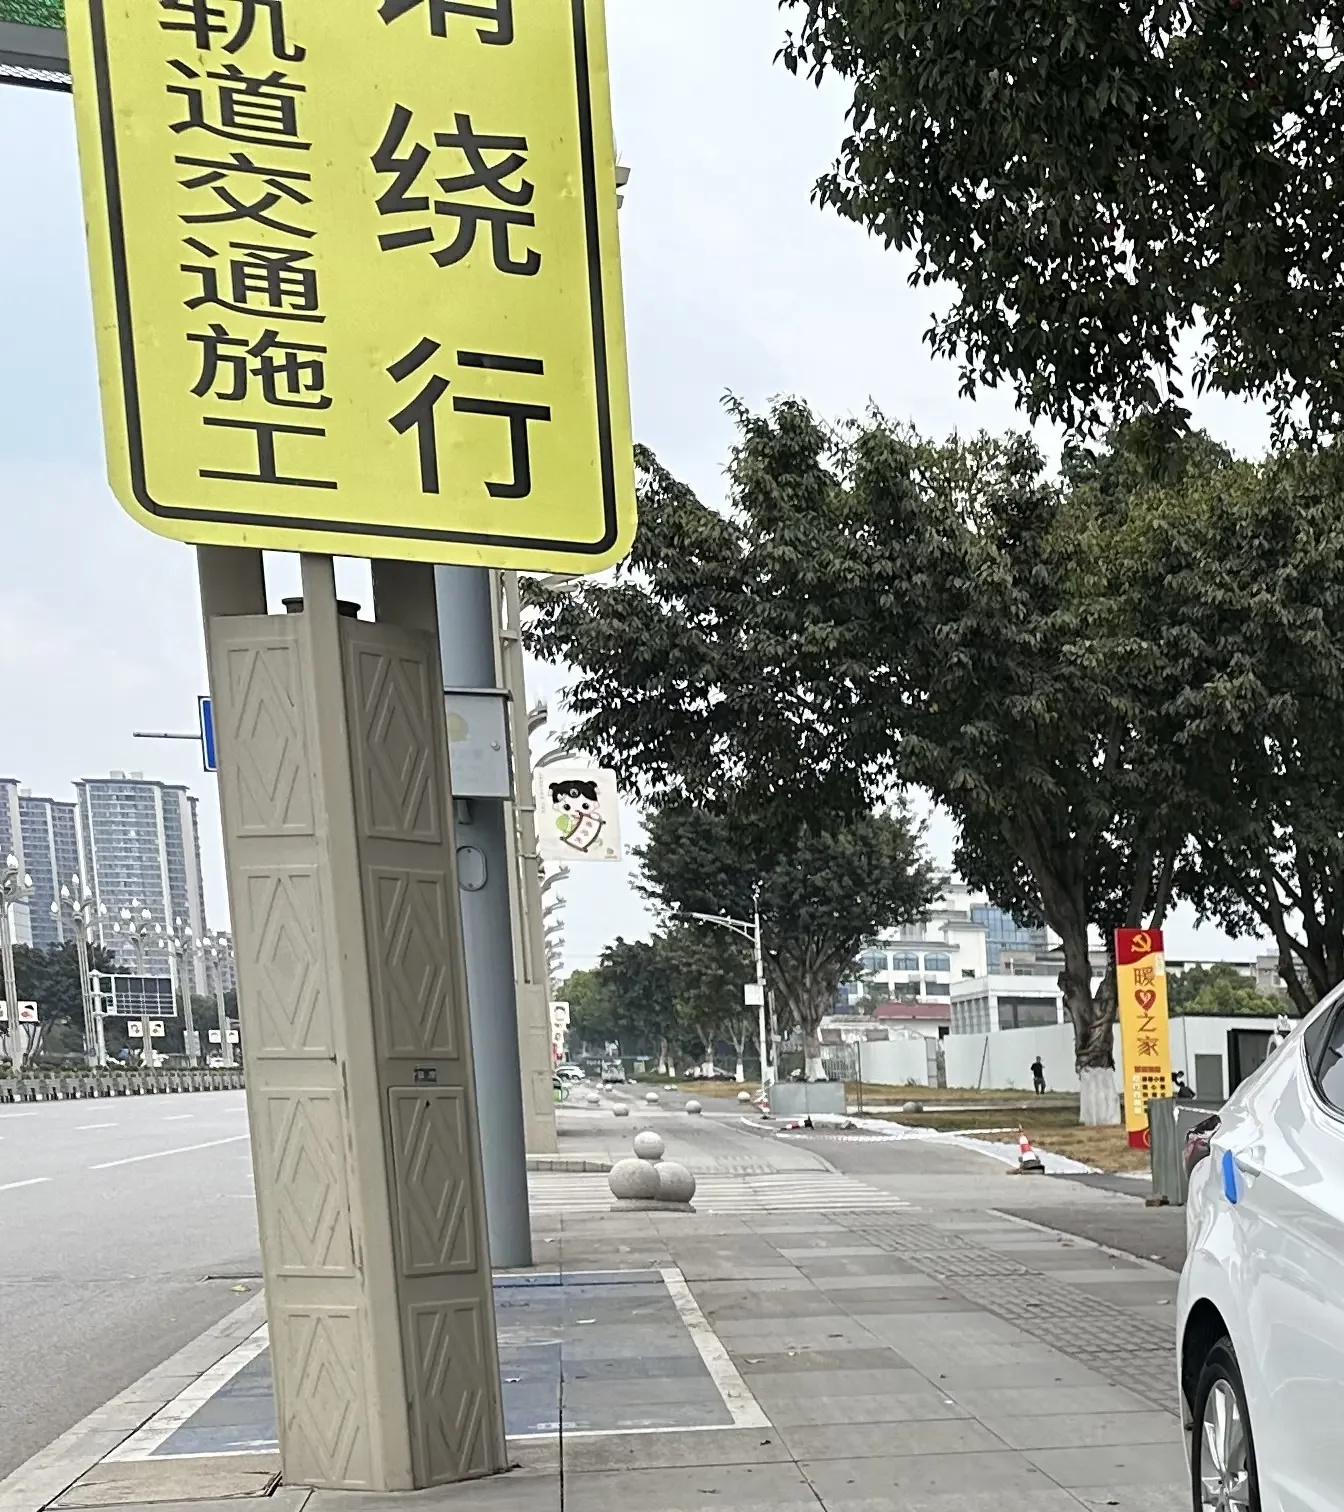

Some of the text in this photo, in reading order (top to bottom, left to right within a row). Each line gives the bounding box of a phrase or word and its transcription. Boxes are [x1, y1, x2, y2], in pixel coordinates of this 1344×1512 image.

[157, 0, 338, 490] 轨道交通施工
[370, 0, 552, 499] 绕行
